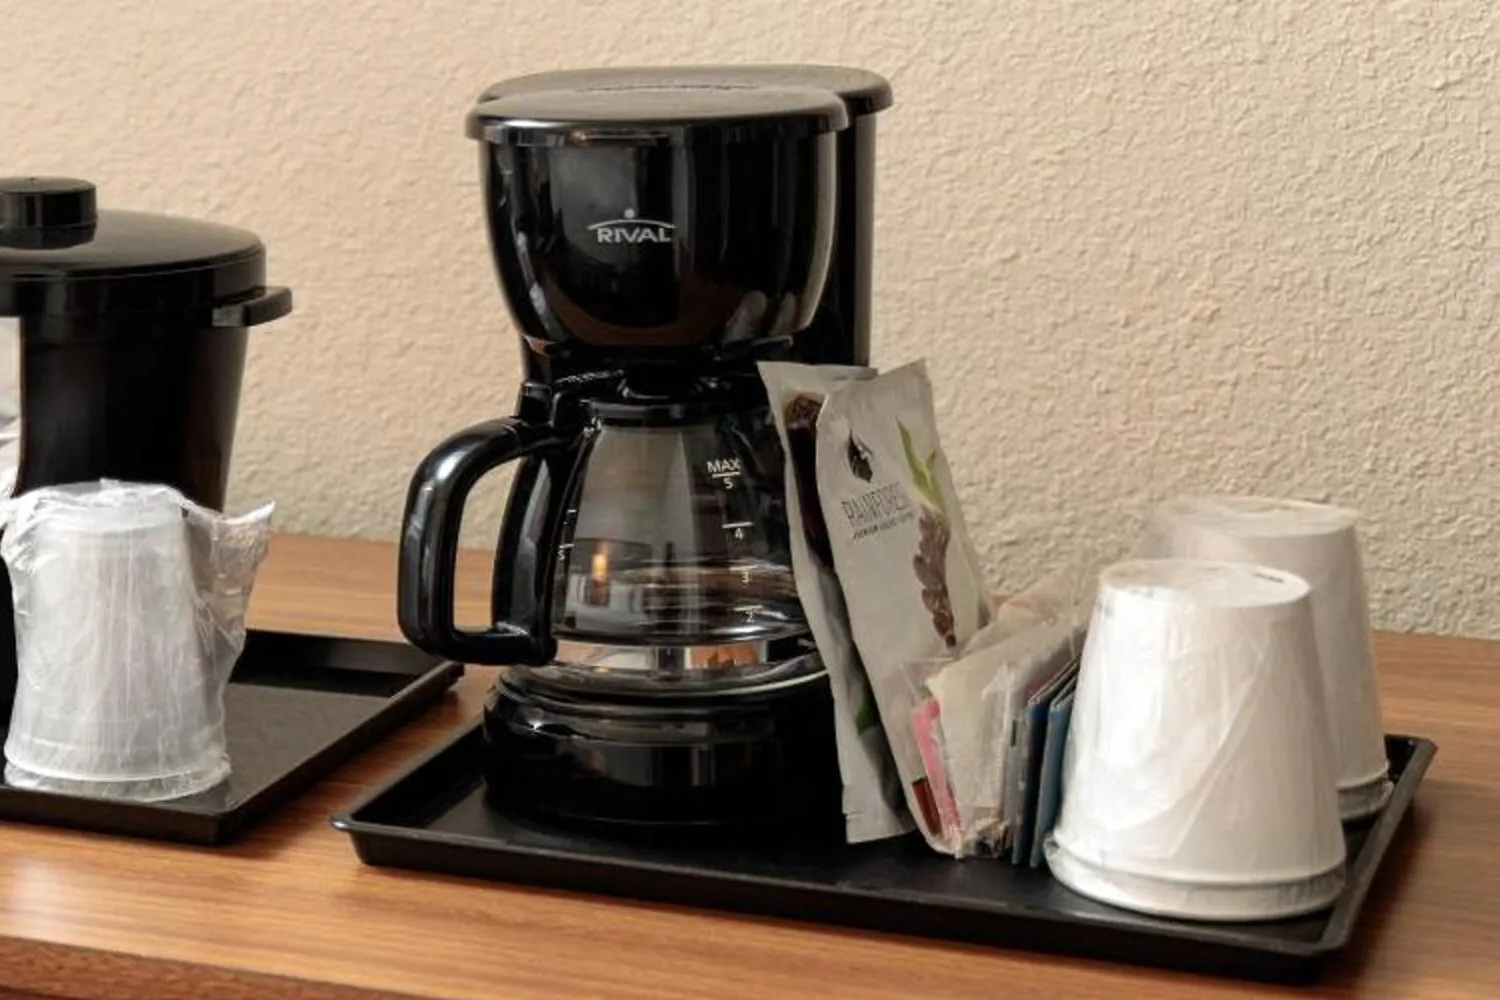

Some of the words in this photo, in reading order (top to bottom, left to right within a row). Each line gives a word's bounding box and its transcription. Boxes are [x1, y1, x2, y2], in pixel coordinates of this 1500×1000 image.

[596, 226, 673, 244] RIVAL
[706, 457, 741, 473] MAX
[723, 478, 733, 490] 5
